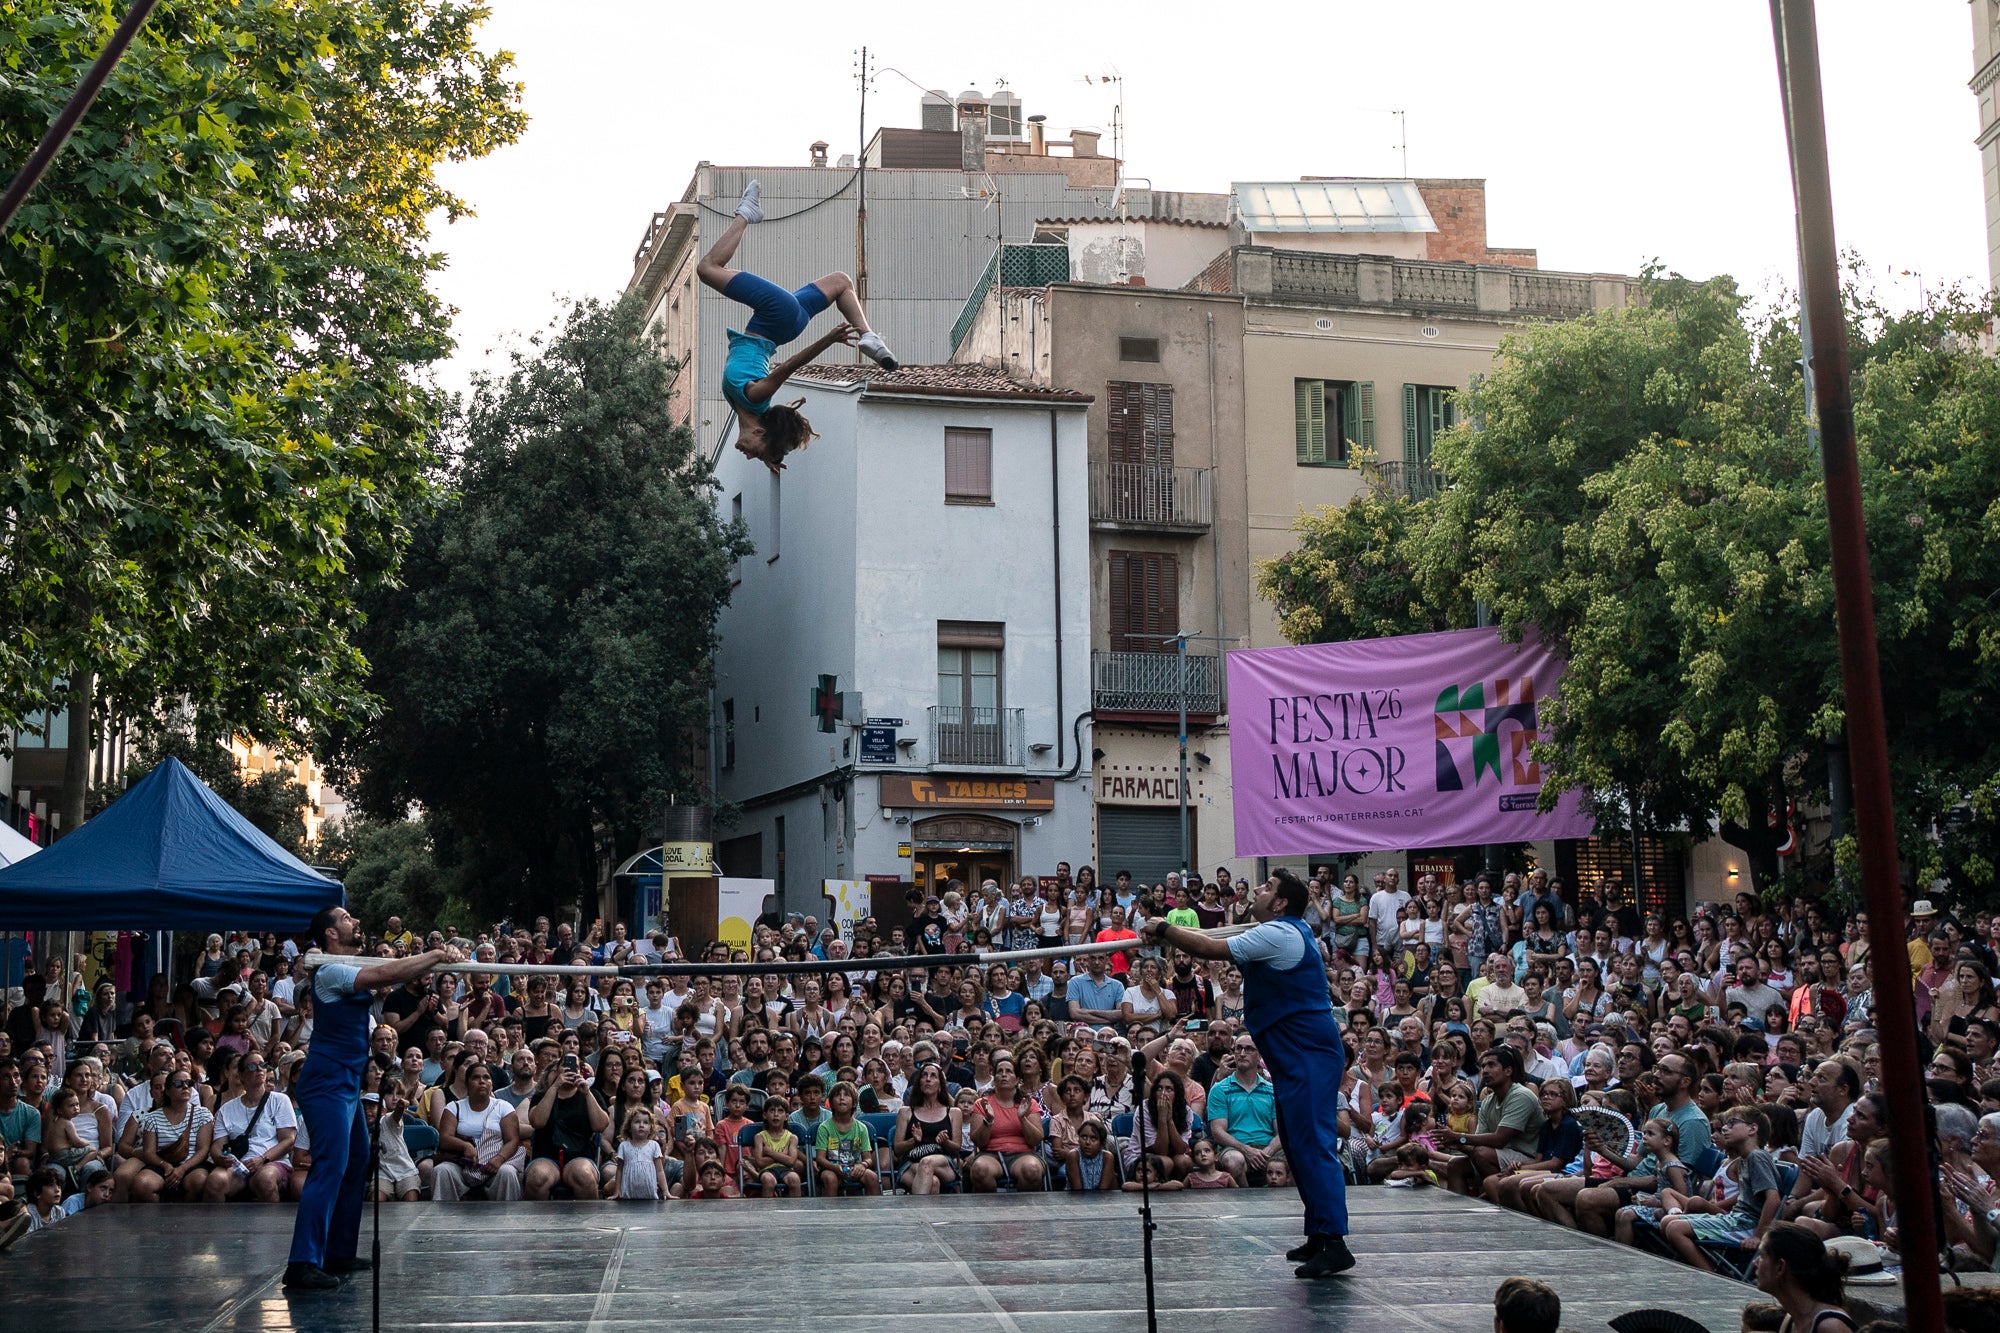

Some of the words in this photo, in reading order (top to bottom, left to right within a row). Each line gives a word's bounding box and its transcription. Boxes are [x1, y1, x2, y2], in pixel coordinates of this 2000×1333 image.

[1268, 691, 1378, 745] FESTA
[1272, 746, 1406, 800] MAJOR
[946, 781, 1027, 798] TABACS
[1102, 776, 1192, 800] FARMACIA
[1274, 808, 1425, 825] FESTAMAJORTERRASSA.CAT
[664, 847, 682, 855] LOVE
[664, 855, 684, 863] LOCAL
[1414, 864, 1455, 872] REBAIXES
